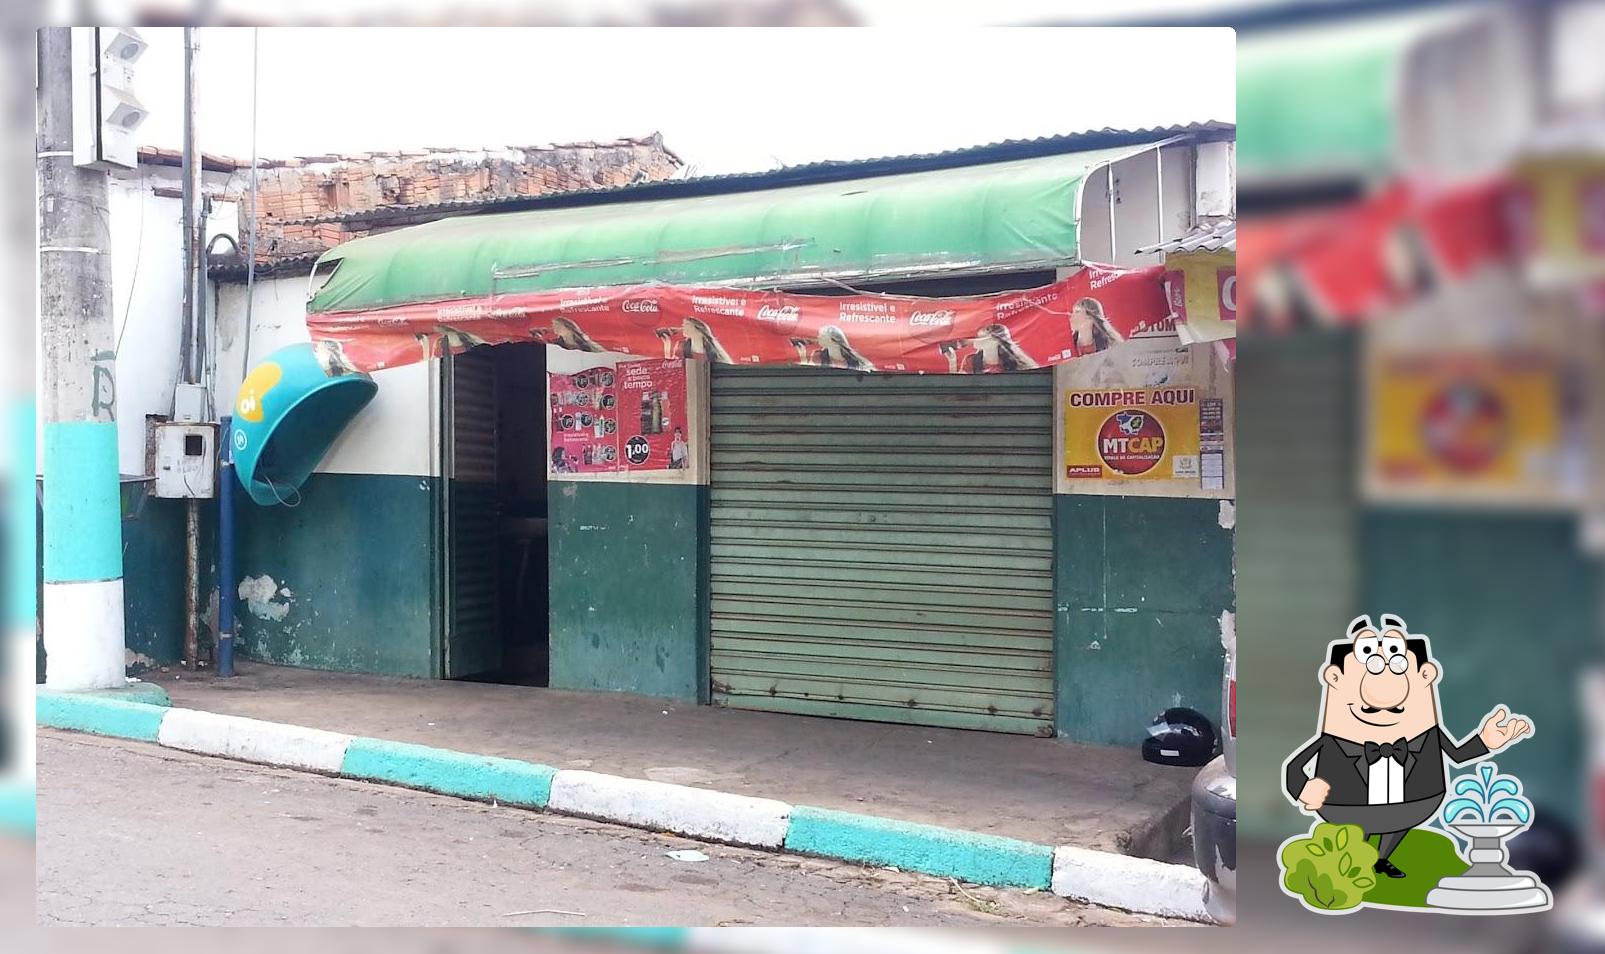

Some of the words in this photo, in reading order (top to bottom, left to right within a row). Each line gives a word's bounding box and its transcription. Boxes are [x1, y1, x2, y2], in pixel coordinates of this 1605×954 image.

[693, 304, 745, 317] Refrescante
[840, 311, 896, 323] Refrescante
[623, 380, 653, 390] tempo
[1070, 391, 1145, 407] COMPRE
[1151, 389, 1194, 405] AQUI
[1103, 436, 1164, 454] MTCAP
